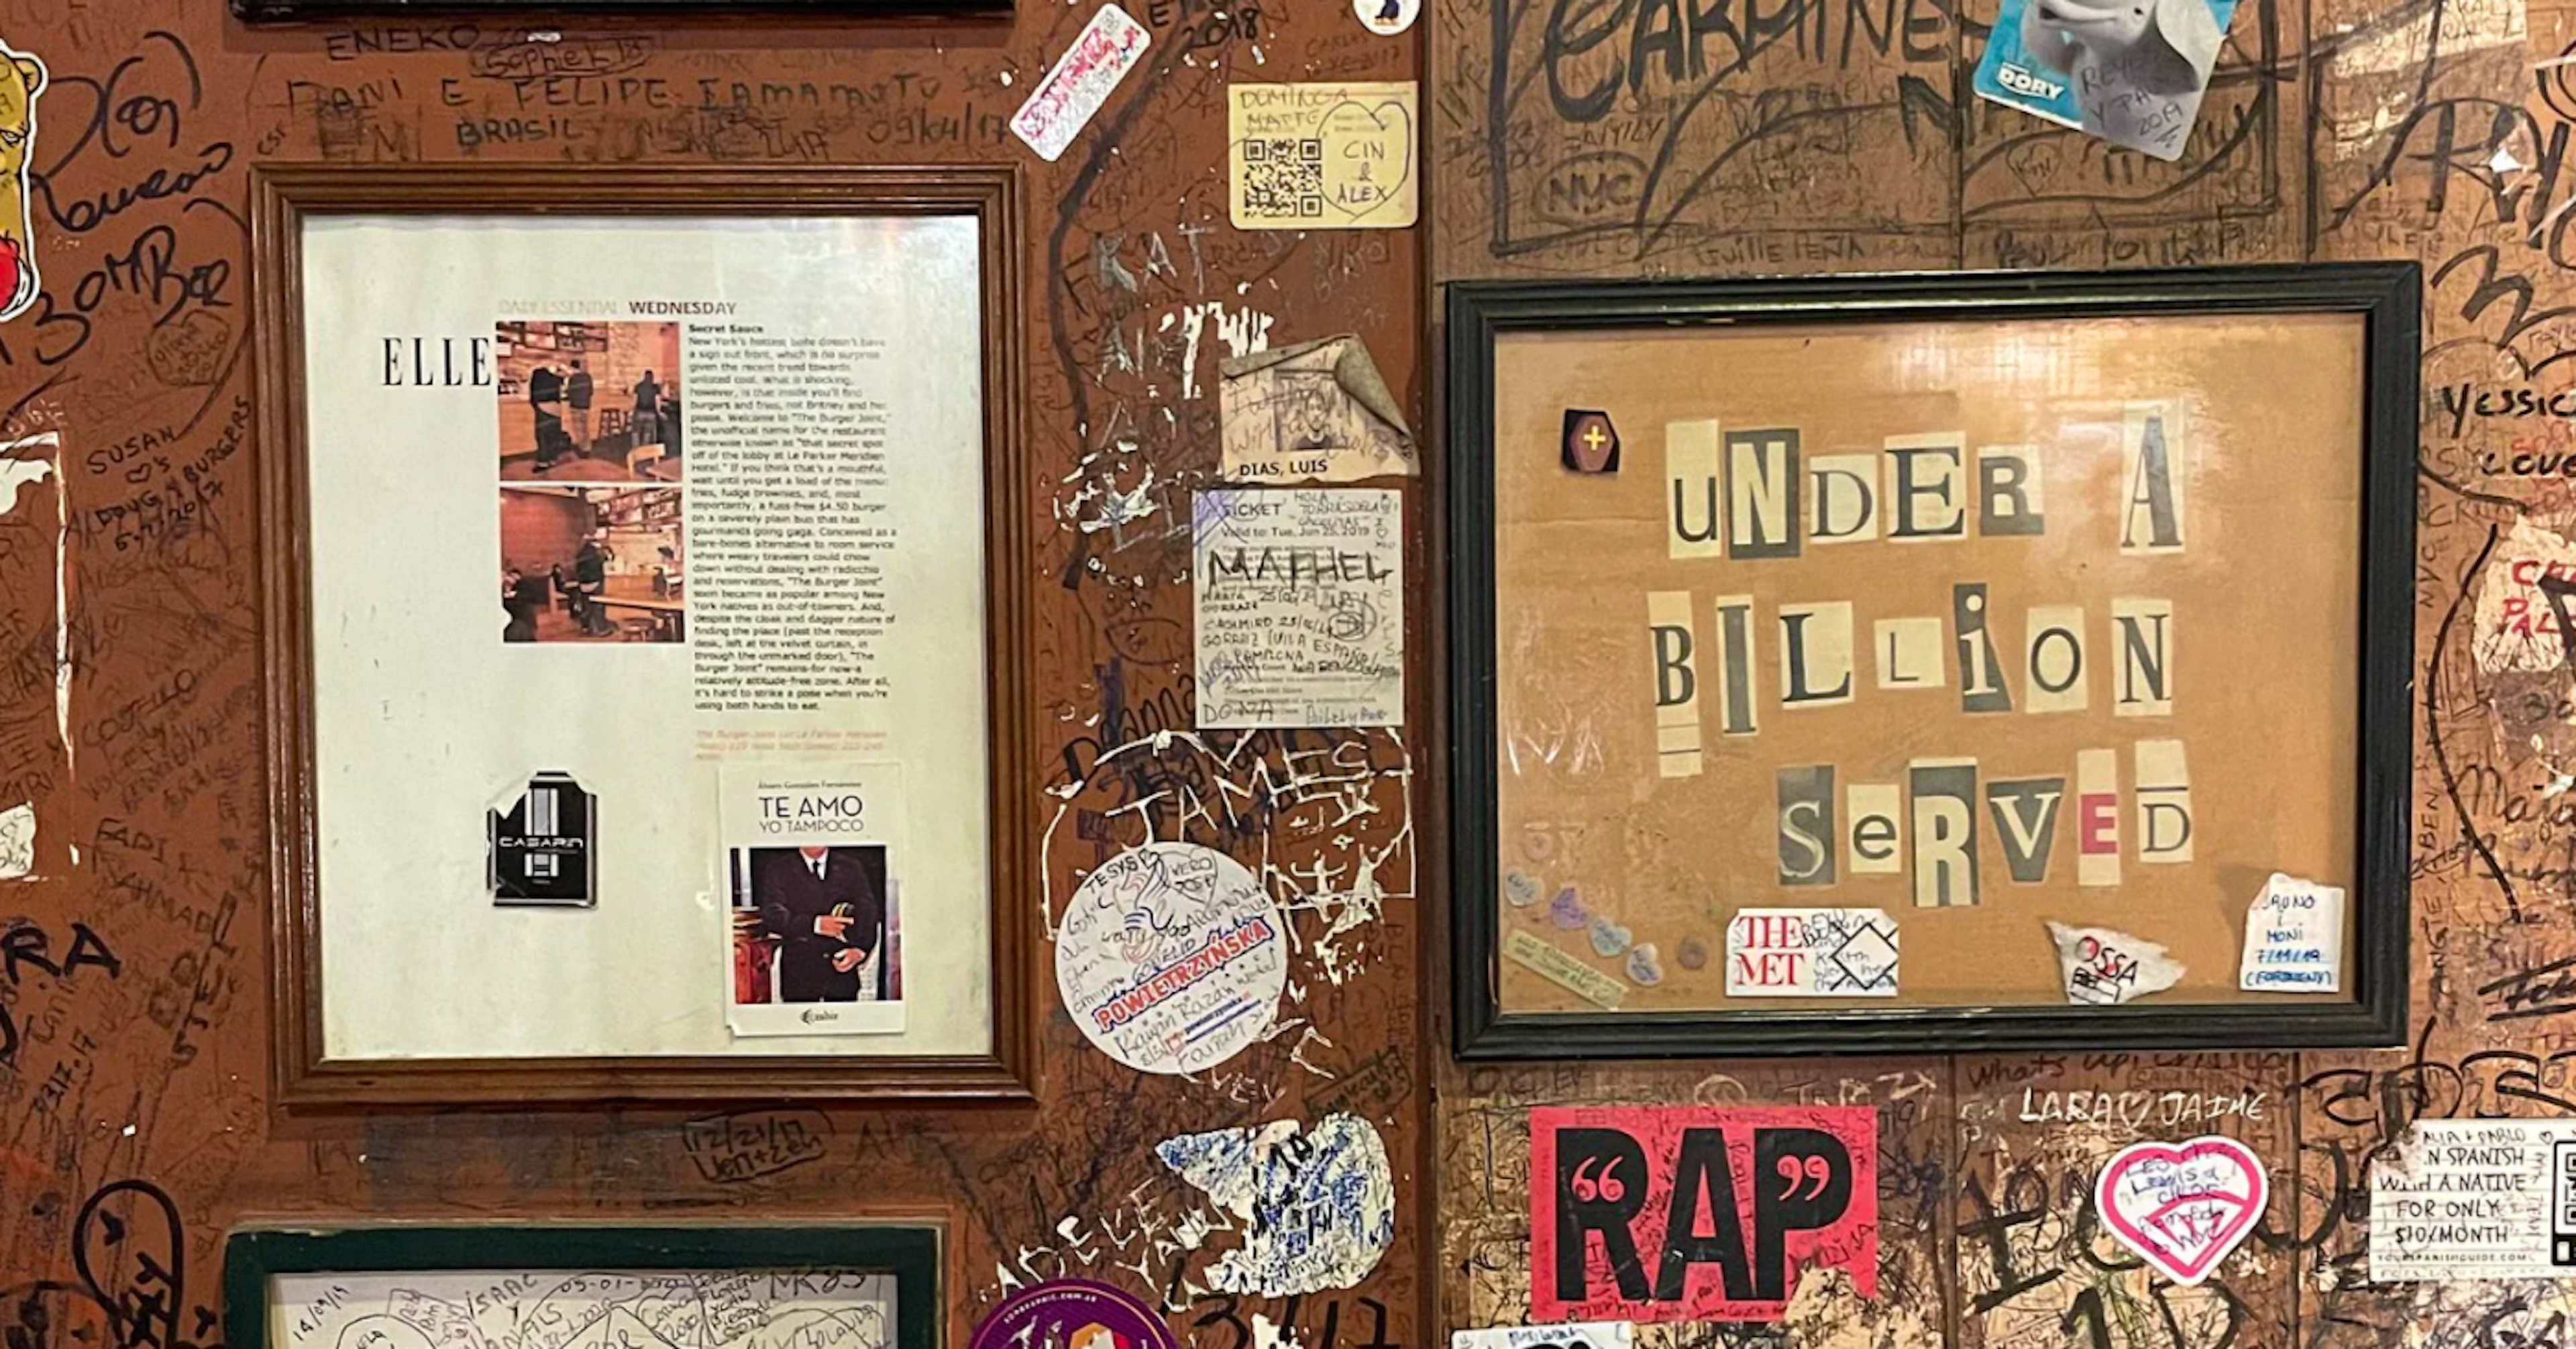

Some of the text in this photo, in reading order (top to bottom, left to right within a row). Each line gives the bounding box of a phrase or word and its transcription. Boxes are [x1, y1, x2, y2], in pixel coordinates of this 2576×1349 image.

[326, 24, 480, 61] ENEKO
[514, 76, 672, 111] FELIPE
[1996, 66, 2064, 101] DORY
[1343, 140, 1385, 161] CIN
[1337, 182, 1388, 203] ALEX
[629, 301, 739, 316] WEDNESDAY
[382, 336, 490, 386] ELLE
[87, 426, 176, 474] SUSAN
[182, 394, 252, 484] BURGERS
[1239, 458, 1329, 478] DIAS, LUIS
[2122, 415, 2183, 547] A
[758, 795, 863, 818] TE AMO
[759, 818, 864, 834] YO TAMPOCO
[2261, 894, 2316, 911] RUNO
[1737, 915, 1804, 950] THE
[1095, 916, 1271, 1032] POWIETRZYŃSKA
[1733, 952, 1807, 987] MET
[2019, 1086, 2269, 1134] LARA JAIME
[2447, 1146, 2525, 1167] SPANISH
[2438, 1173, 2454, 1191] A
[2459, 1174, 2527, 1192] NATIVE
[2396, 1199, 2500, 1218] FOR ONLY
[2395, 1224, 2509, 1244] $10/MONTH
